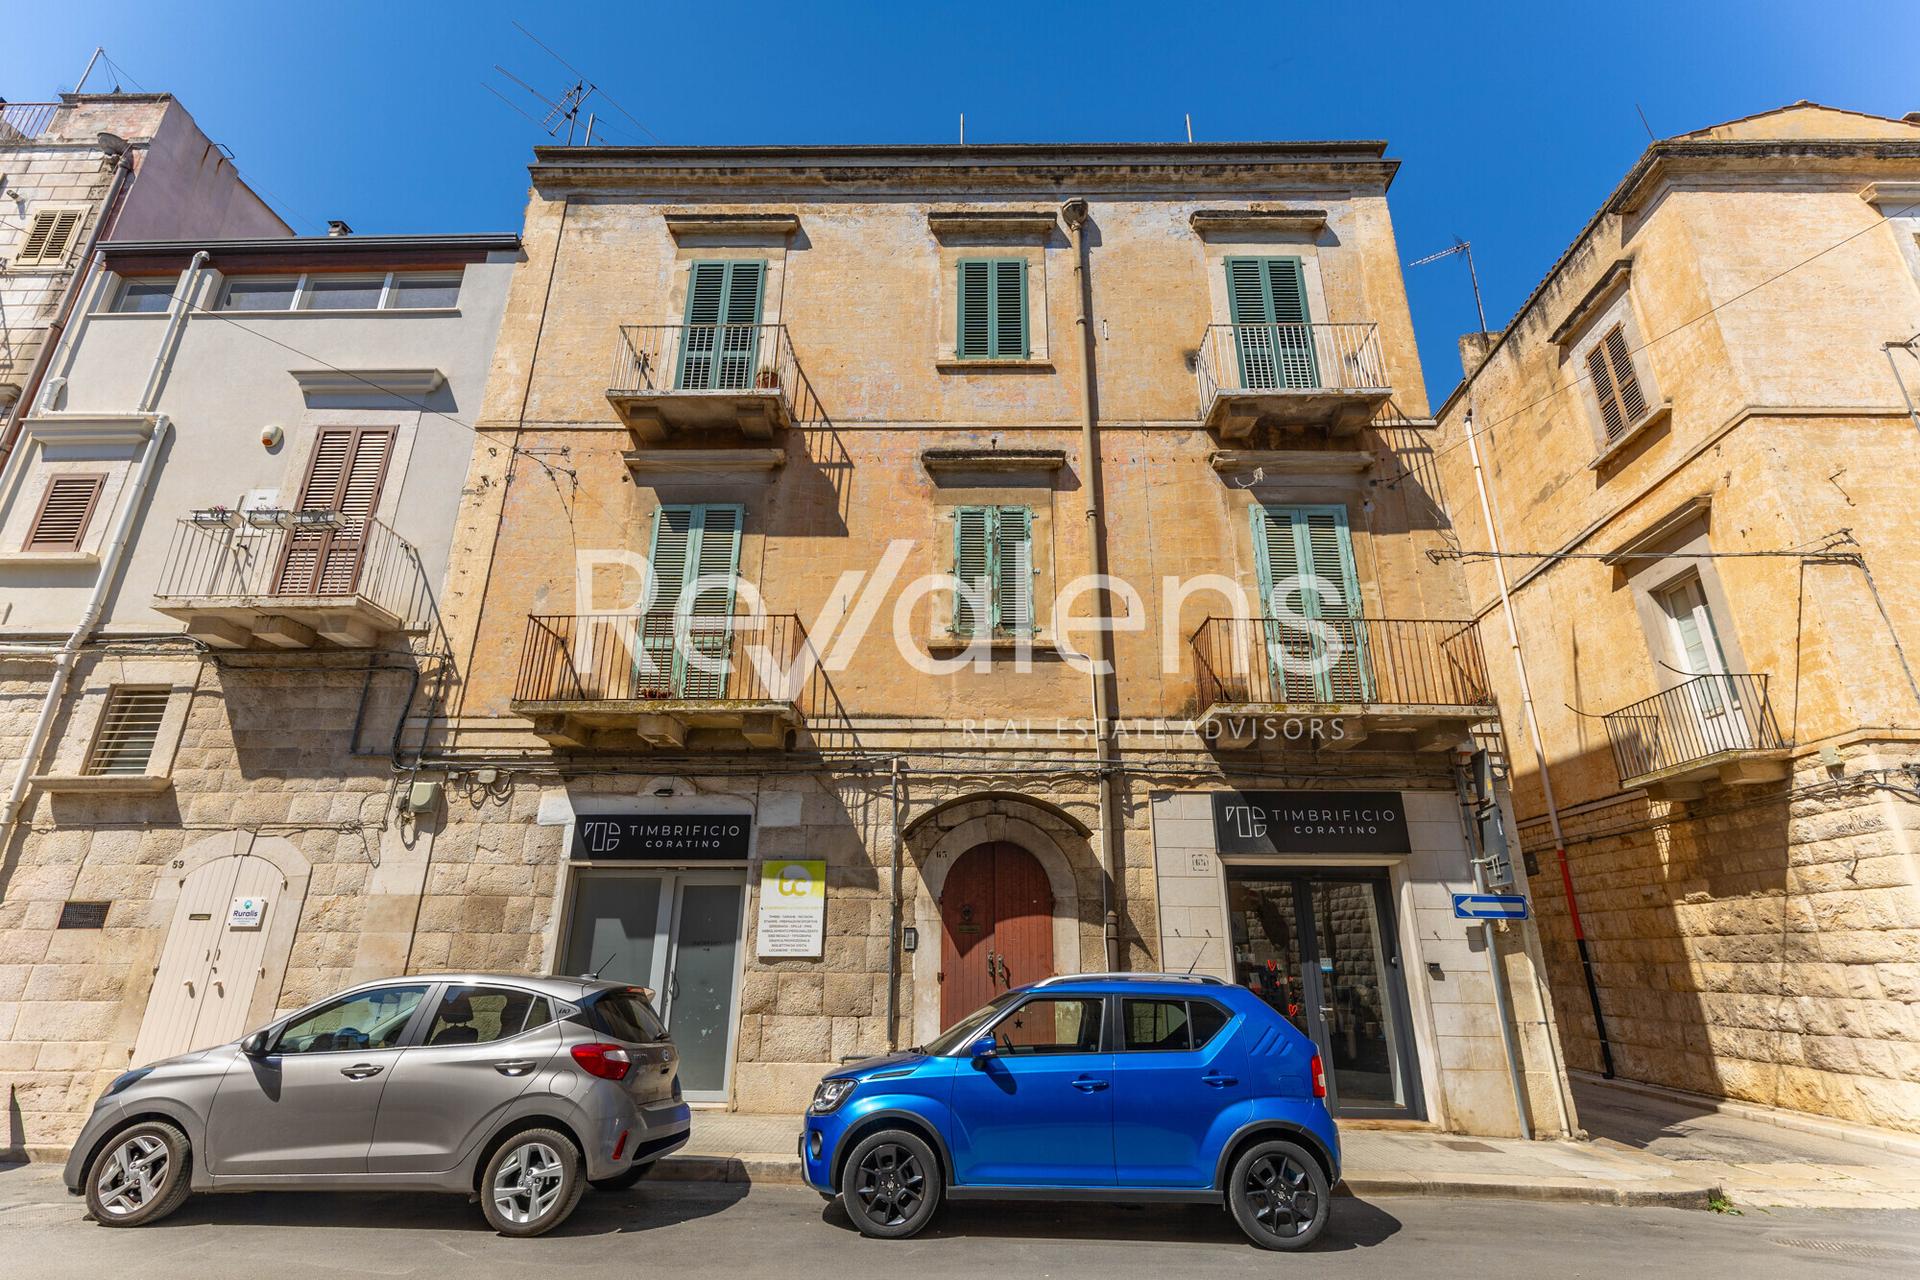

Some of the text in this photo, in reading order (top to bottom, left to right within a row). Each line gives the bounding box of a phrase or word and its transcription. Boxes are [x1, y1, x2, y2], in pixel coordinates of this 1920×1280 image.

[1271, 809, 1395, 822] TIMBRIFICIO
[629, 825, 740, 837] TIMBRIFICIO
[1293, 825, 1377, 835] CORATINO
[645, 840, 720, 849] CORATINO
[172, 860, 184, 869] 59
